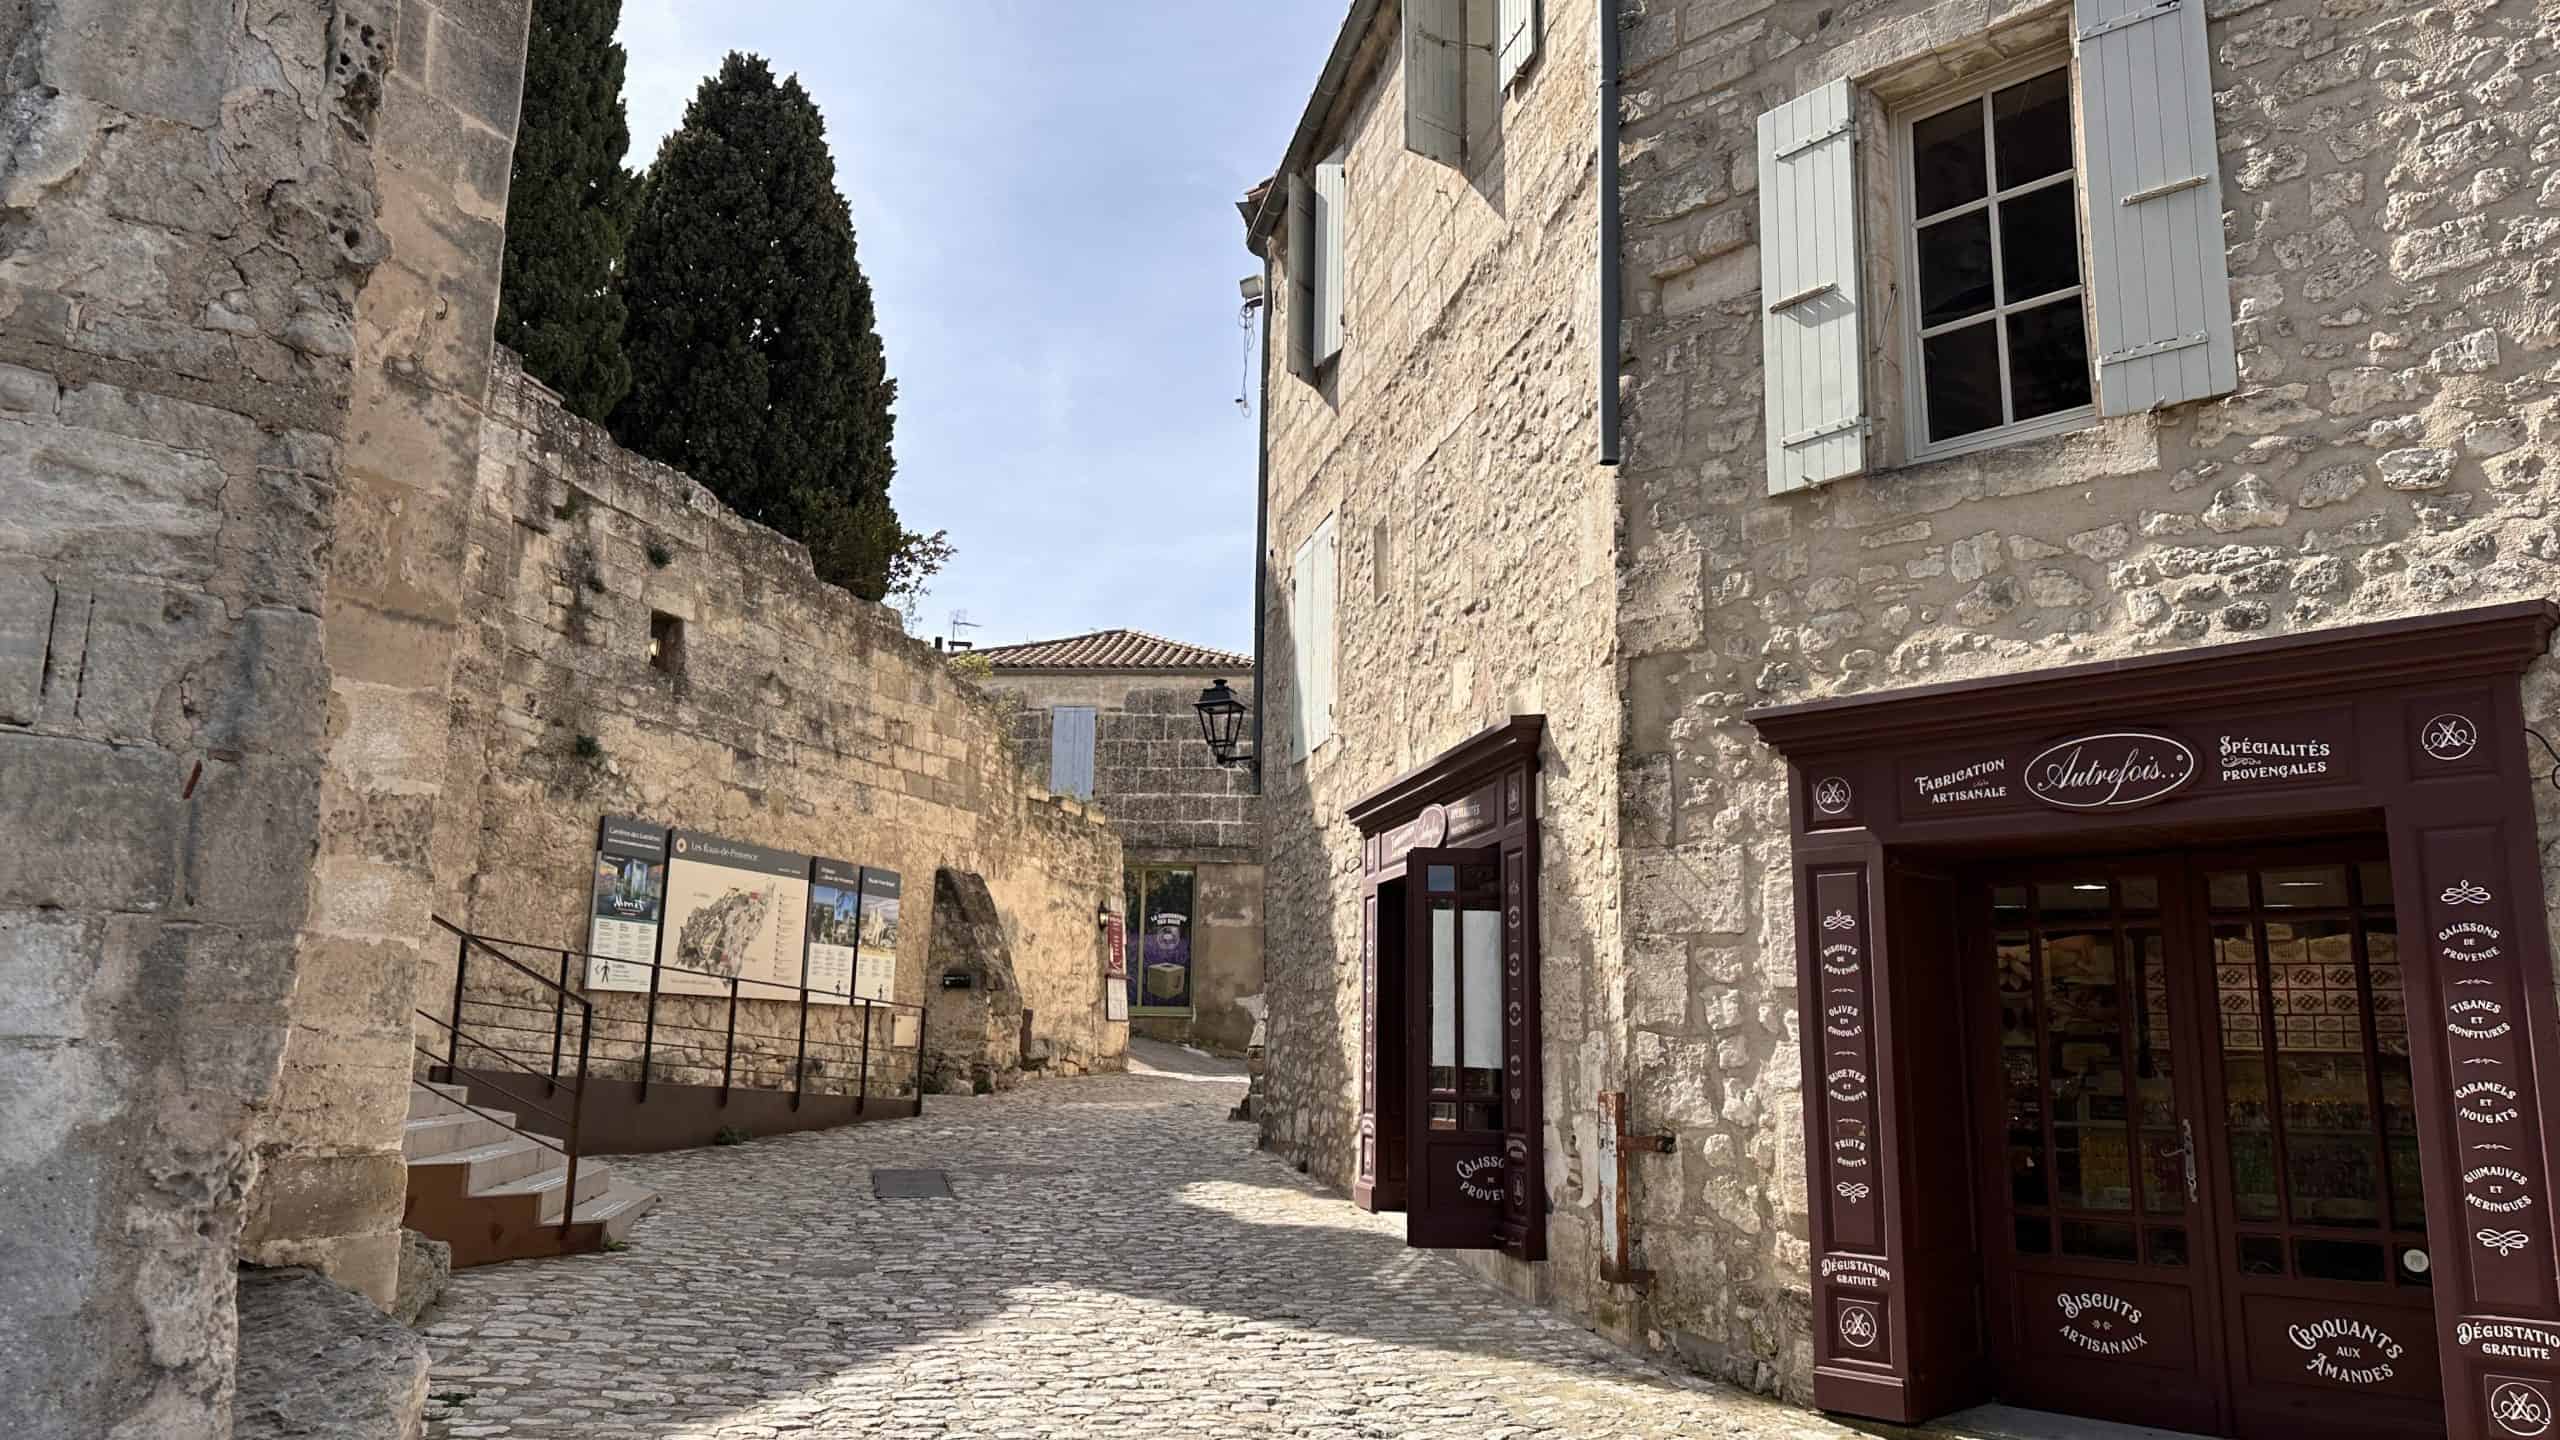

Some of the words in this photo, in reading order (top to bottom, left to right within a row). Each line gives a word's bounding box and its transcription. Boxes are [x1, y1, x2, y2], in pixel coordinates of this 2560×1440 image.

[1914, 758, 2006, 795] FABRICATION
[2223, 761, 2328, 781] PROVENÇALES
[1932, 786, 2007, 804] ARTISANALE
[2439, 922, 2501, 942] CALISSONS
[2442, 946, 2501, 962] PROVENCE
[2449, 999, 2503, 1014] TISANES
[2448, 1022, 2511, 1041] CONFITURES
[2455, 1081, 2517, 1101] CARAMELS
[2479, 1098, 2493, 1107] ET
[2459, 1107, 2518, 1125] NOUGATS
[2464, 1166, 2528, 1186] GUIMAUVES
[2490, 1185, 2503, 1194] ET
[2465, 1193, 2532, 1213] MERINGUES
[1821, 1258, 1891, 1281] DÉGUSTATION
[2057, 1293, 2143, 1325] BISCUITS
[2058, 1324, 2149, 1355] ARTISANAUX
[2288, 1318, 2404, 1359] CROQUANTS
[2335, 1345, 2362, 1359] AUX
[2482, 1342, 2551, 1361] GRATUITE
[2306, 1352, 2394, 1384] AMANDES
